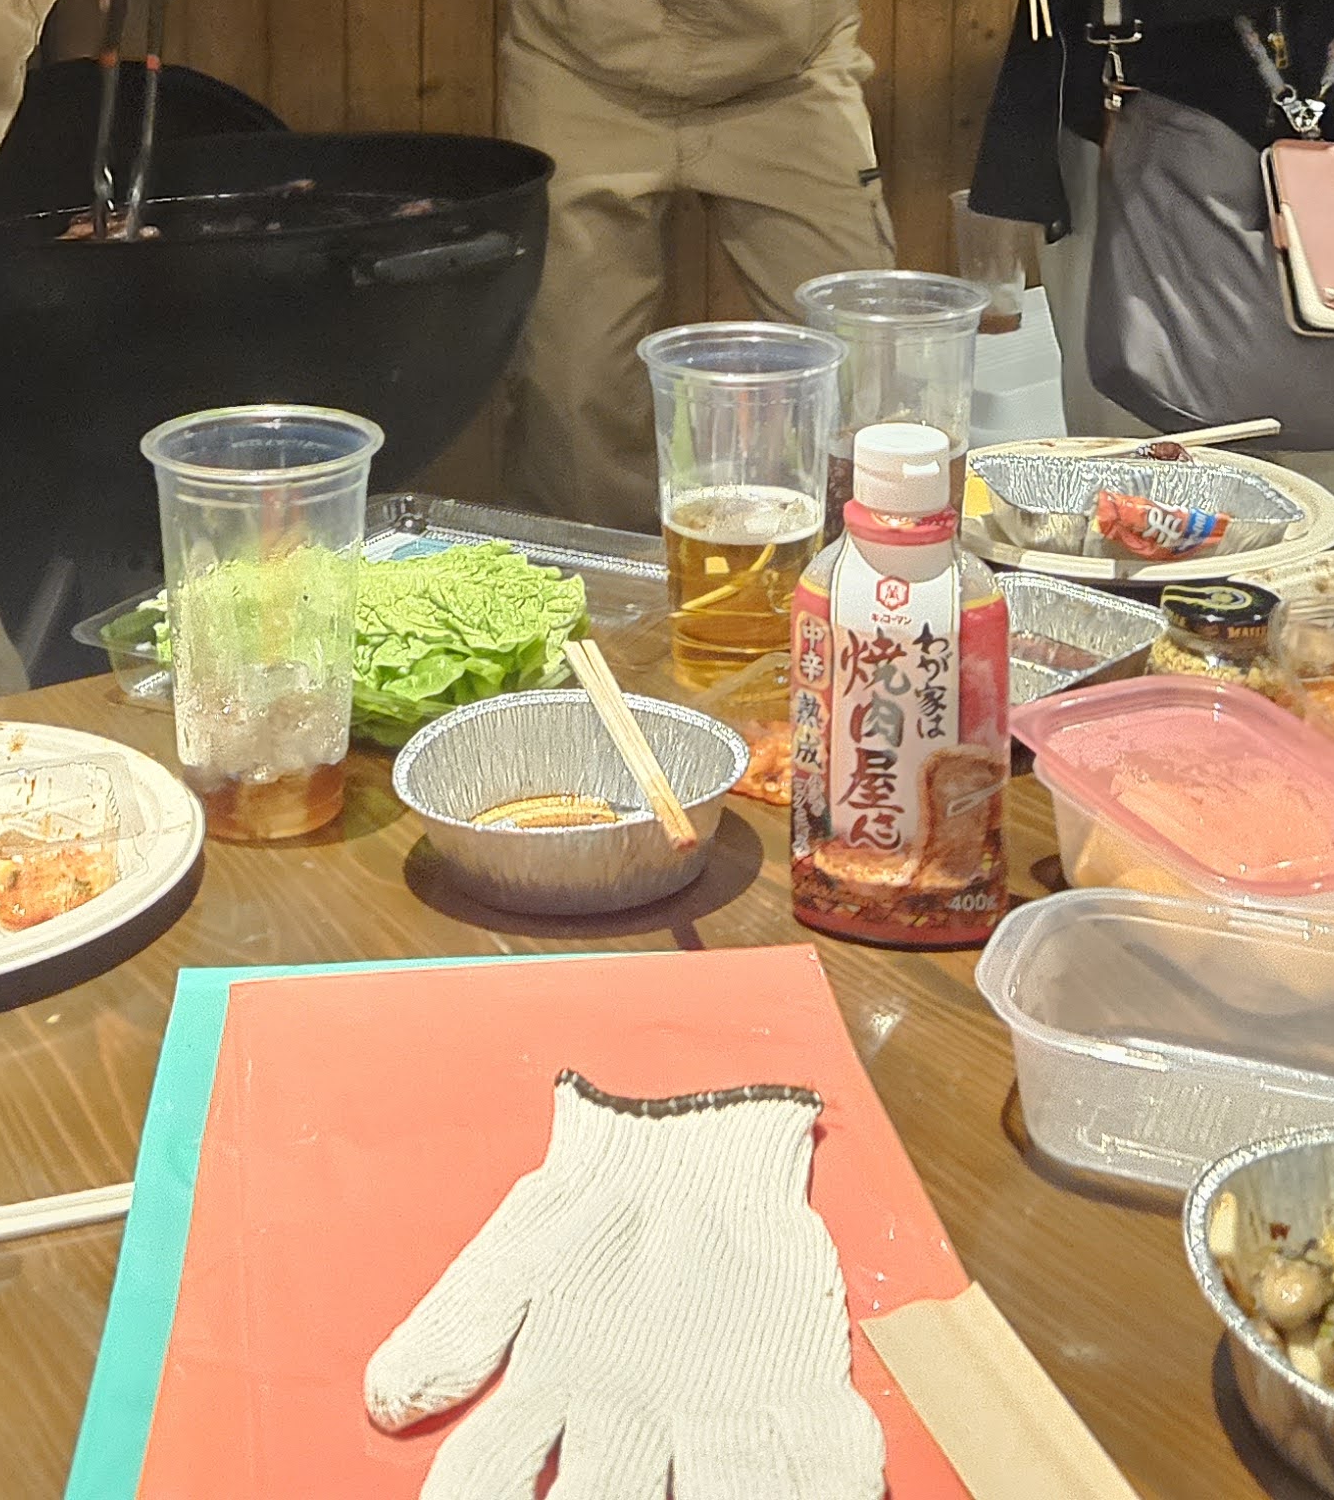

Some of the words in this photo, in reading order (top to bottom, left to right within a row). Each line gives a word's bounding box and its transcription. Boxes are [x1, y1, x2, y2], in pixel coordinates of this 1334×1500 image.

[800, 618, 825, 683] 中辛
[871, 613, 912, 625] キッコーマン
[912, 621, 953, 739] わが家は
[837, 626, 910, 849] 焼肉屋さん
